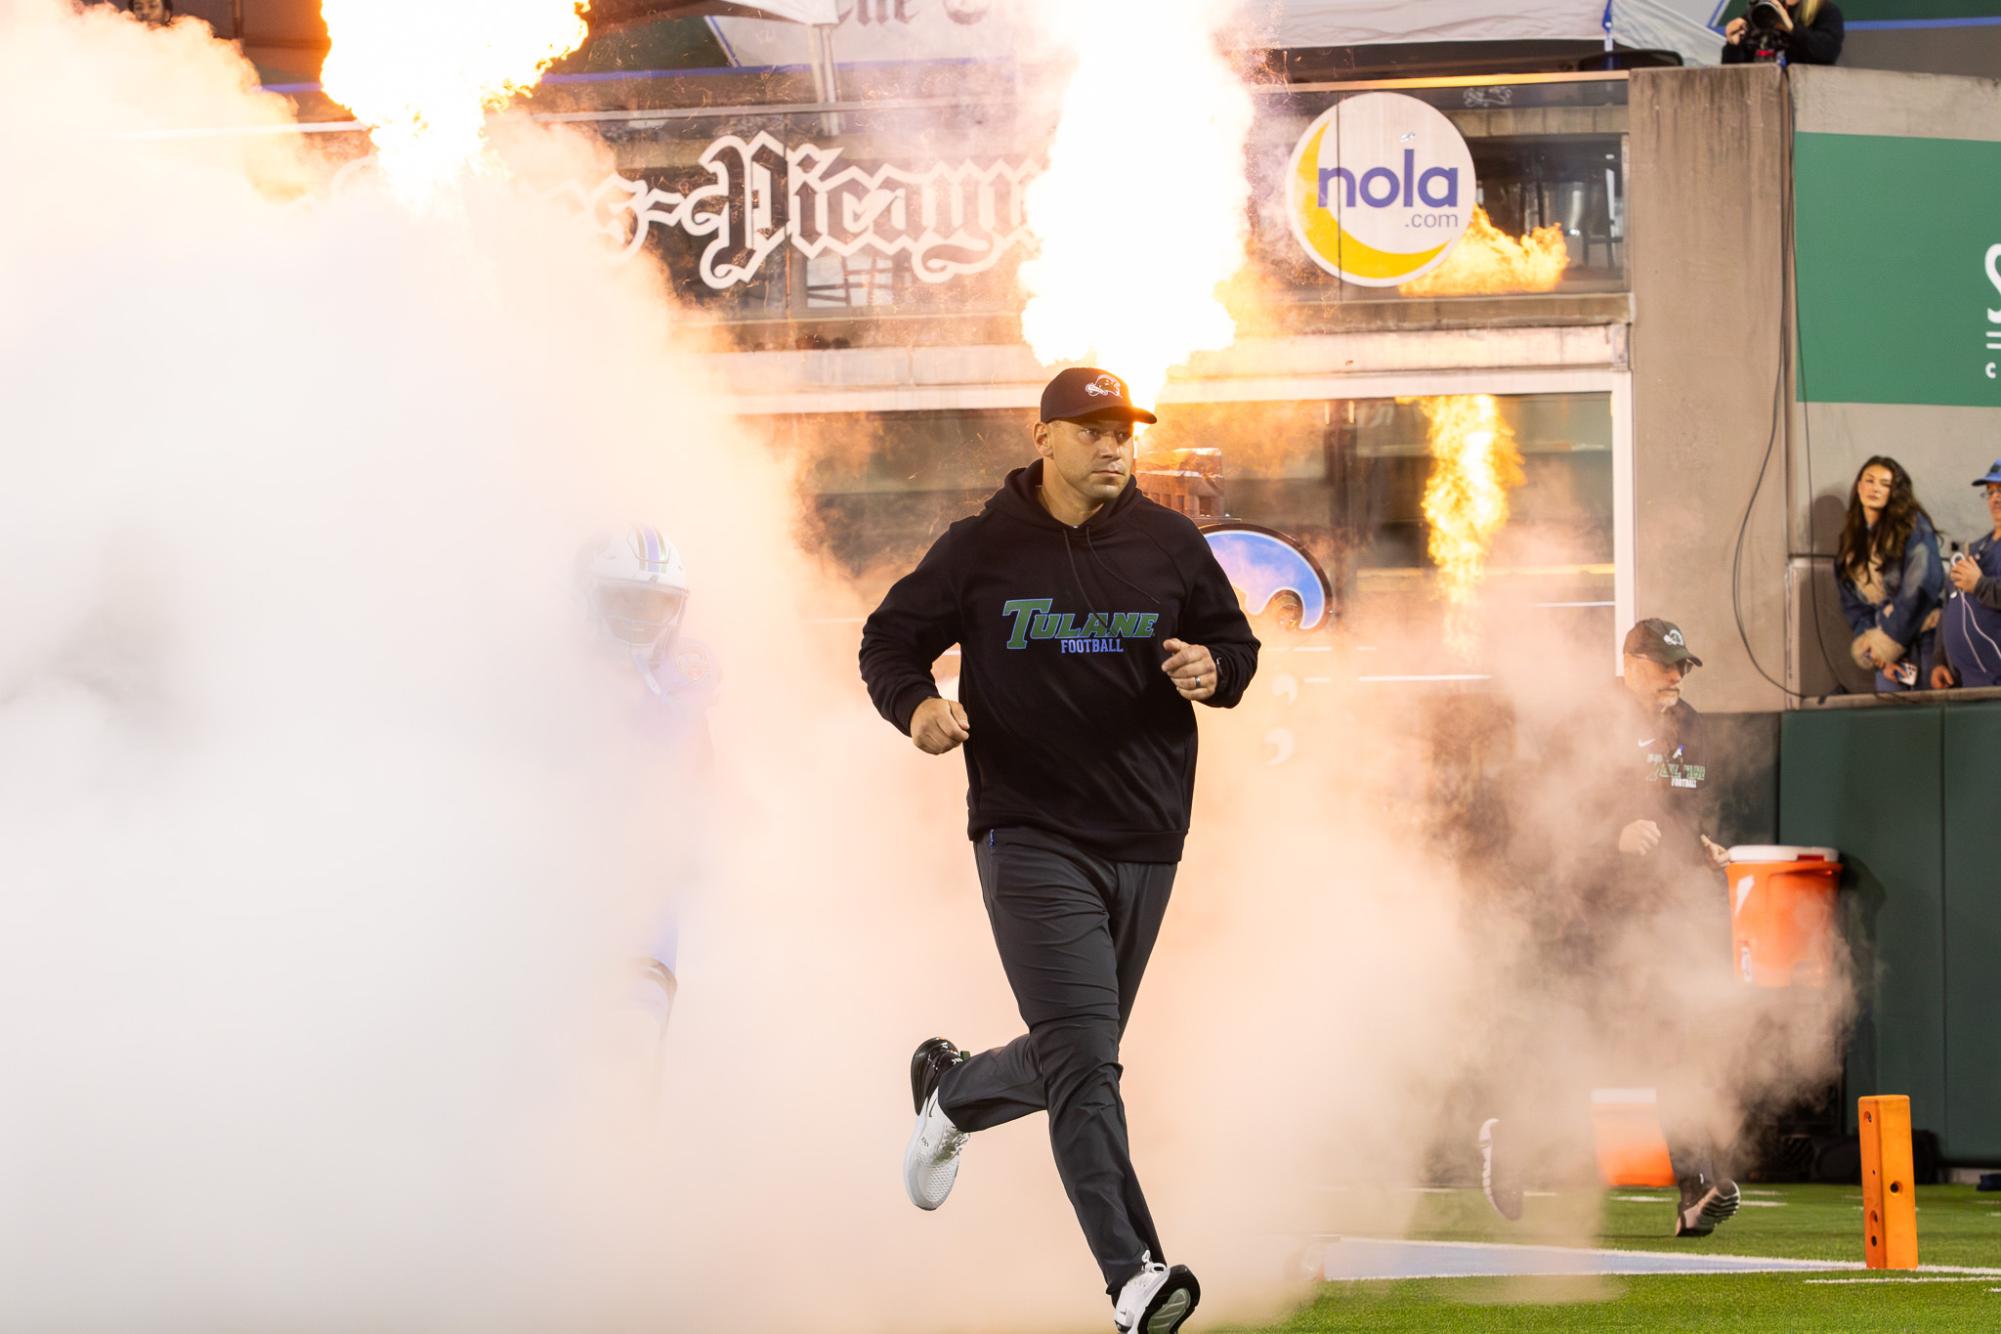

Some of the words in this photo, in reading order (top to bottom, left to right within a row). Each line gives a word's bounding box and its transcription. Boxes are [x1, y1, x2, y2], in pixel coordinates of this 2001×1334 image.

[1317, 148, 1459, 208] nola
[1404, 212, 1458, 229] .com
[1060, 638, 1124, 653] FOOTBALL
